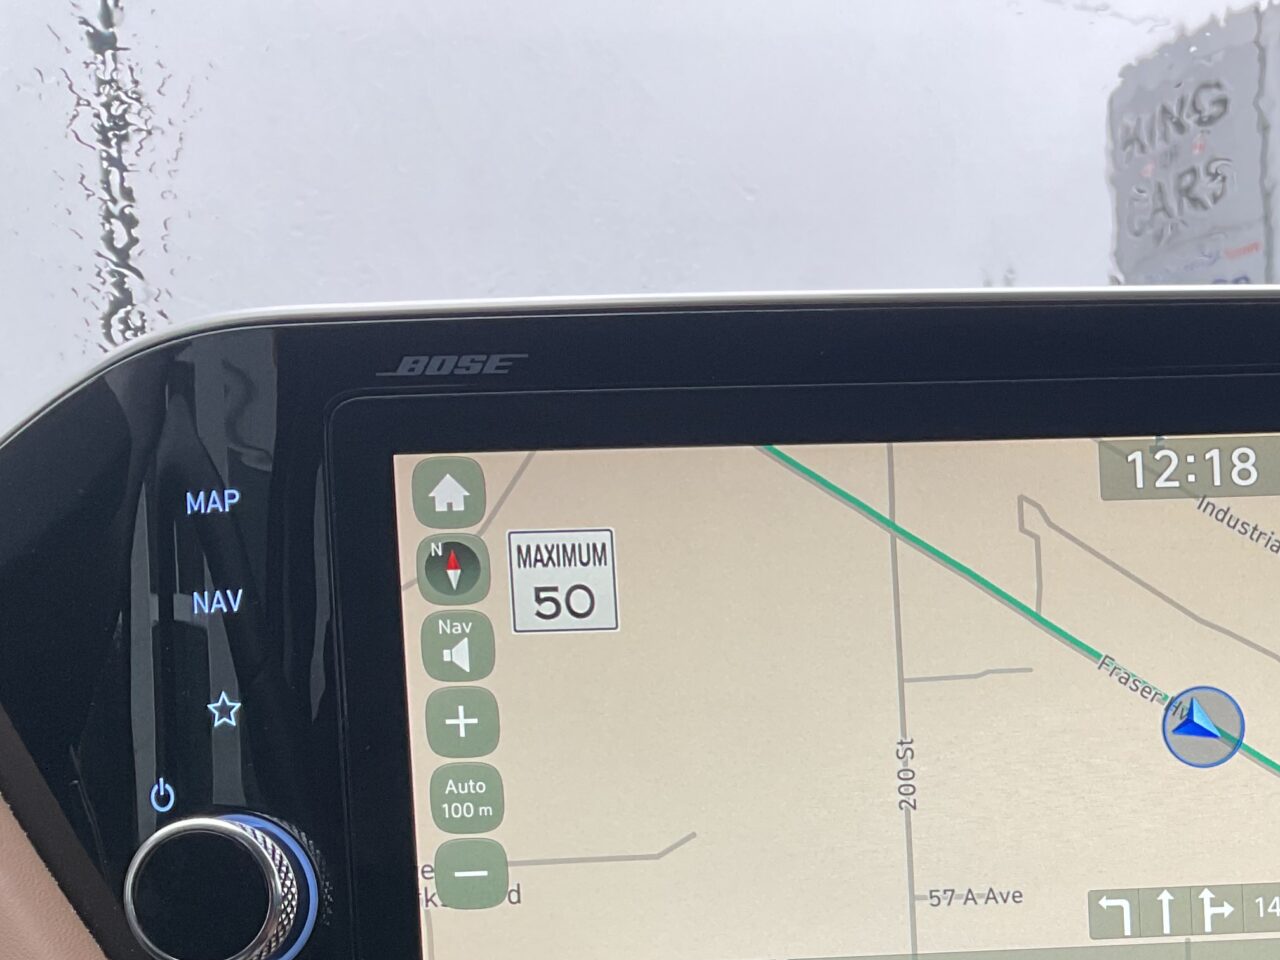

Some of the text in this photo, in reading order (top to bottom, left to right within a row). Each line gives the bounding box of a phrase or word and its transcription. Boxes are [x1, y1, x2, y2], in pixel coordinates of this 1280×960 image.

[376, 354, 528, 377] BOSE
[1127, 446, 1258, 488] 12:18
[186, 489, 240, 515] MAP
[430, 542, 443, 557] N
[516, 541, 608, 569] MAXIMUM
[193, 589, 243, 614] NAV
[534, 584, 595, 620] 50
[438, 619, 472, 635] Nav
[1098, 654, 1162, 702] Fraser
[445, 779, 486, 795] Auto
[896, 738, 916, 811] 200 St
[442, 803, 493, 818] 100 m
[928, 887, 1024, 907] 57 A Ave
